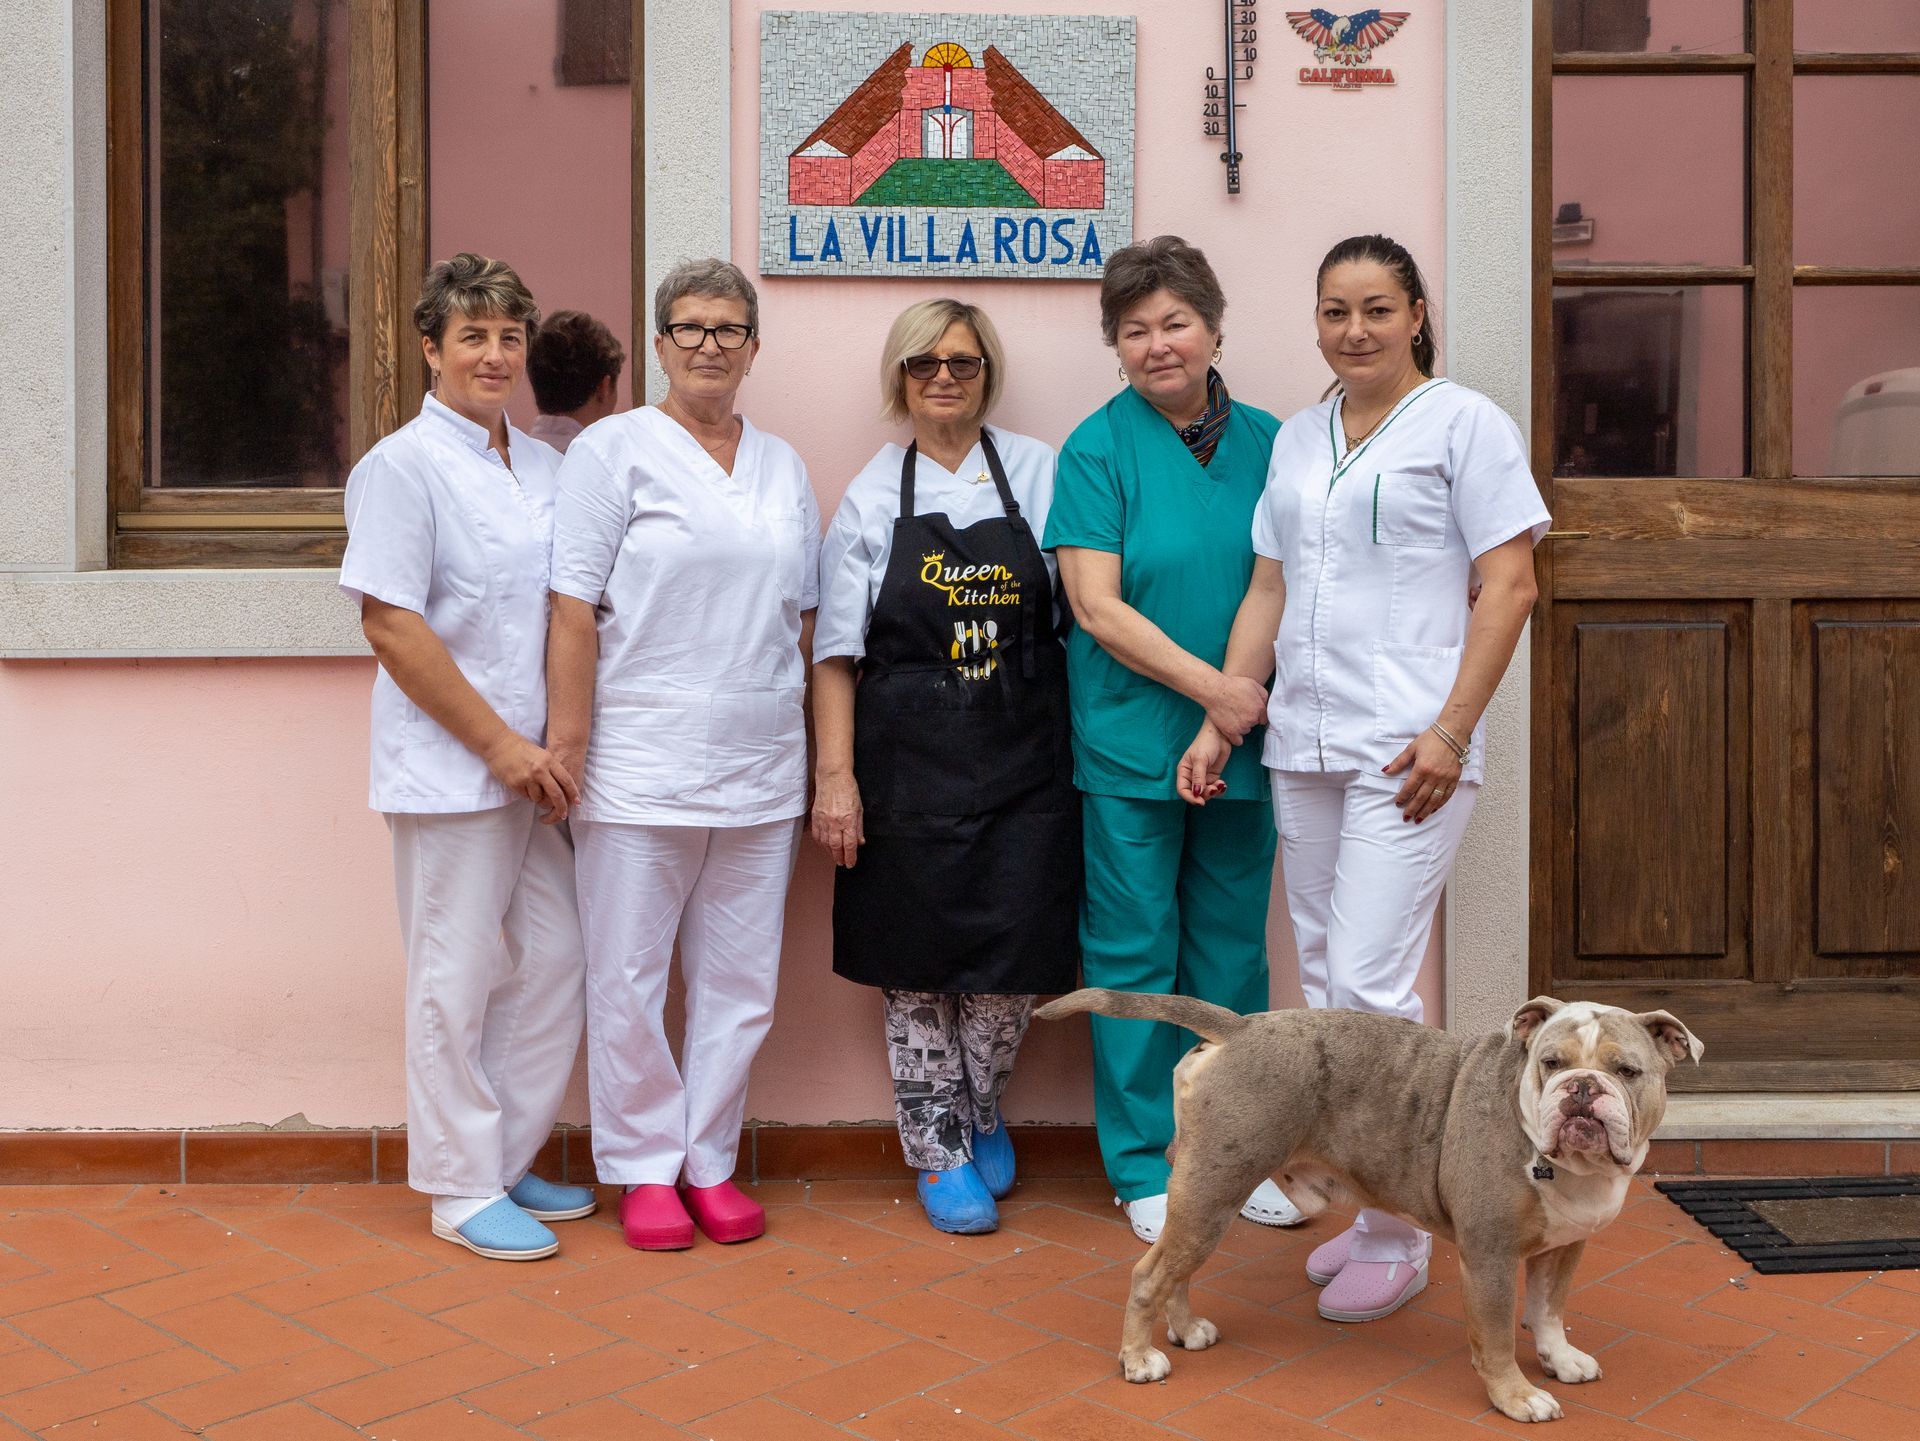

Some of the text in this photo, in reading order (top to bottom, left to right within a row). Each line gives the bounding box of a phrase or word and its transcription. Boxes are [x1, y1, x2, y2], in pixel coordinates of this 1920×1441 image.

[1240, 10, 1257, 24] 30
[1241, 29, 1257, 42] 20
[1243, 47, 1257, 61] 10
[1206, 66, 1214, 79] 0
[1245, 65, 1254, 78] 0
[1299, 67, 1395, 83] CALIFORNIA
[1204, 84, 1219, 98] 10
[1203, 103, 1219, 116] 20
[1203, 121, 1219, 135] 30
[789, 215, 1104, 266] LA VILLA ROSA
[920, 561, 1012, 590] Queen
[1000, 580, 1021, 592] of the
[947, 585, 1021, 607] Kitchen
